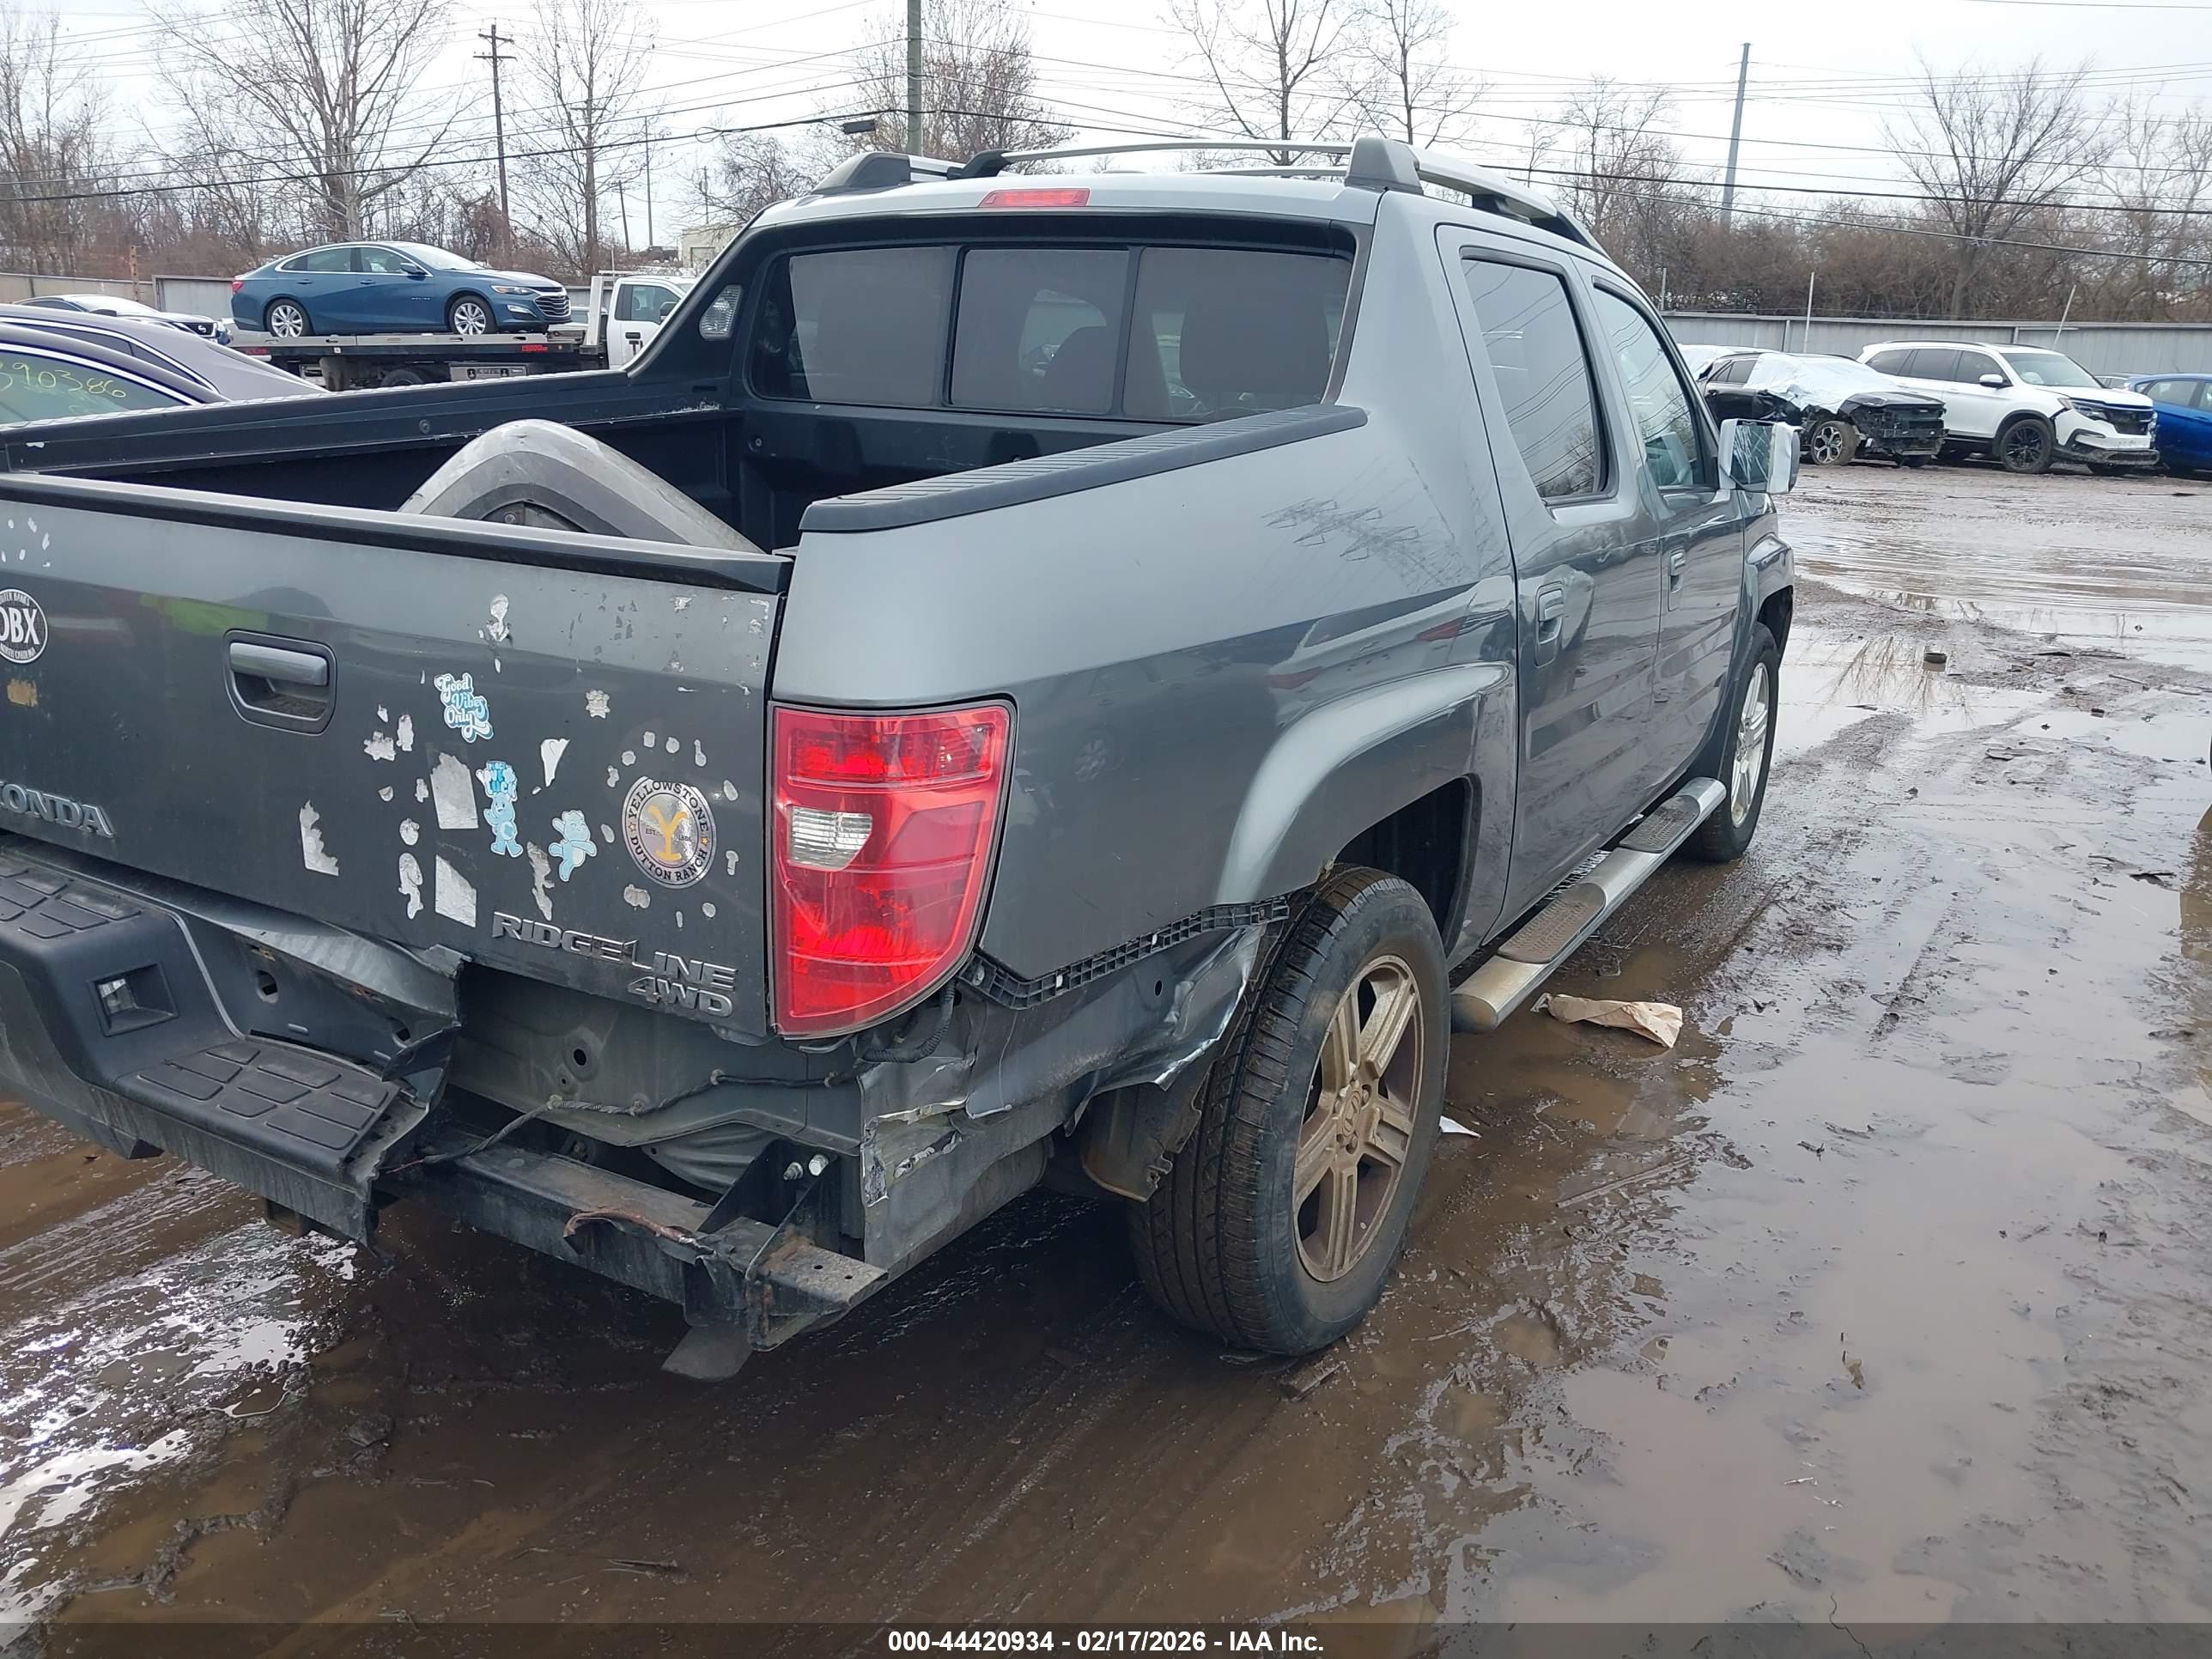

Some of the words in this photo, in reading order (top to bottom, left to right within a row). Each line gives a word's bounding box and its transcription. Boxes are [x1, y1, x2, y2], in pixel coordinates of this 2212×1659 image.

[434, 674, 471, 702] Good
[451, 690, 486, 720] Vibes
[446, 707, 491, 738] Only
[0, 781, 112, 837] ONDA
[628, 781, 709, 832] YELLOWSTONE
[630, 836, 672, 881] DUTTON
[674, 848, 708, 881] RANCH
[491, 911, 738, 991] RIDGELINE
[628, 975, 733, 1018] 4WD
